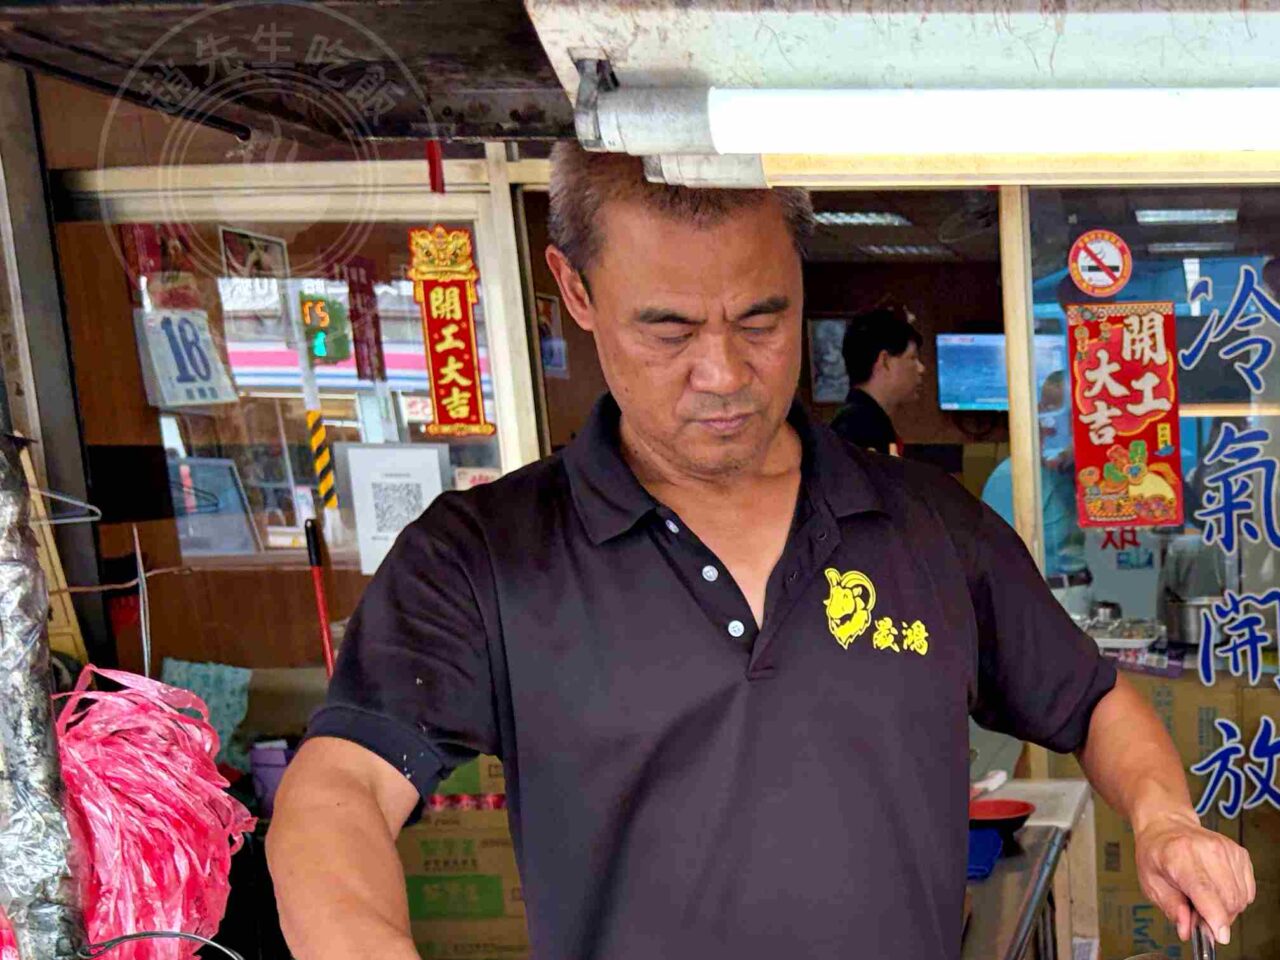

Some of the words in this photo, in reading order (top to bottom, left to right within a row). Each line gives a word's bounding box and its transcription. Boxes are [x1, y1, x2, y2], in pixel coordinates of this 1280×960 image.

[428, 285, 473, 420] 開工大吉
[1079, 348, 1131, 446] 大吉
[1121, 311, 1172, 417] 開工
